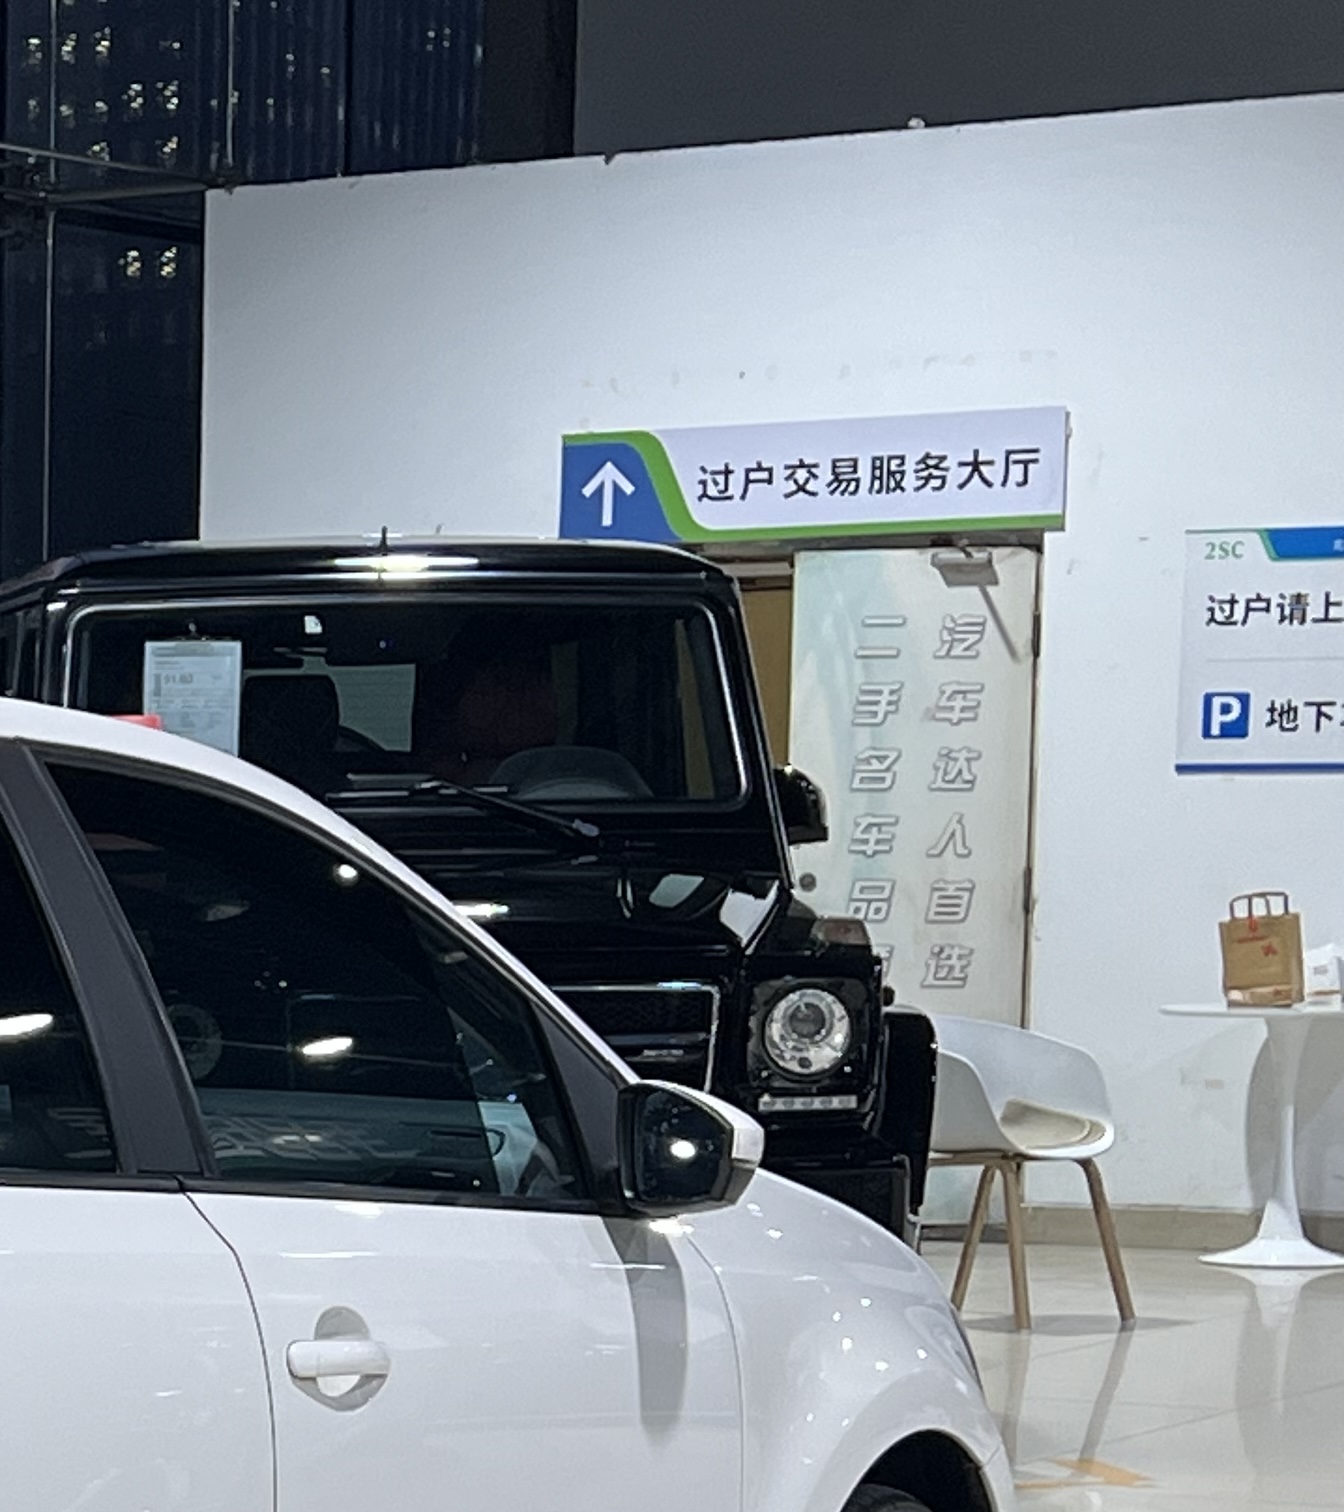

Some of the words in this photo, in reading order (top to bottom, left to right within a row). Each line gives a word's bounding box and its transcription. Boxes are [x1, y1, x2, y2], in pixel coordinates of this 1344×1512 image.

[697, 447, 1041, 503] 过户交易服务大厅
[1204, 540, 1246, 560] 2SC
[1265, 698, 1344, 733] 地下
[920, 613, 987, 989] 汽车达人首选
